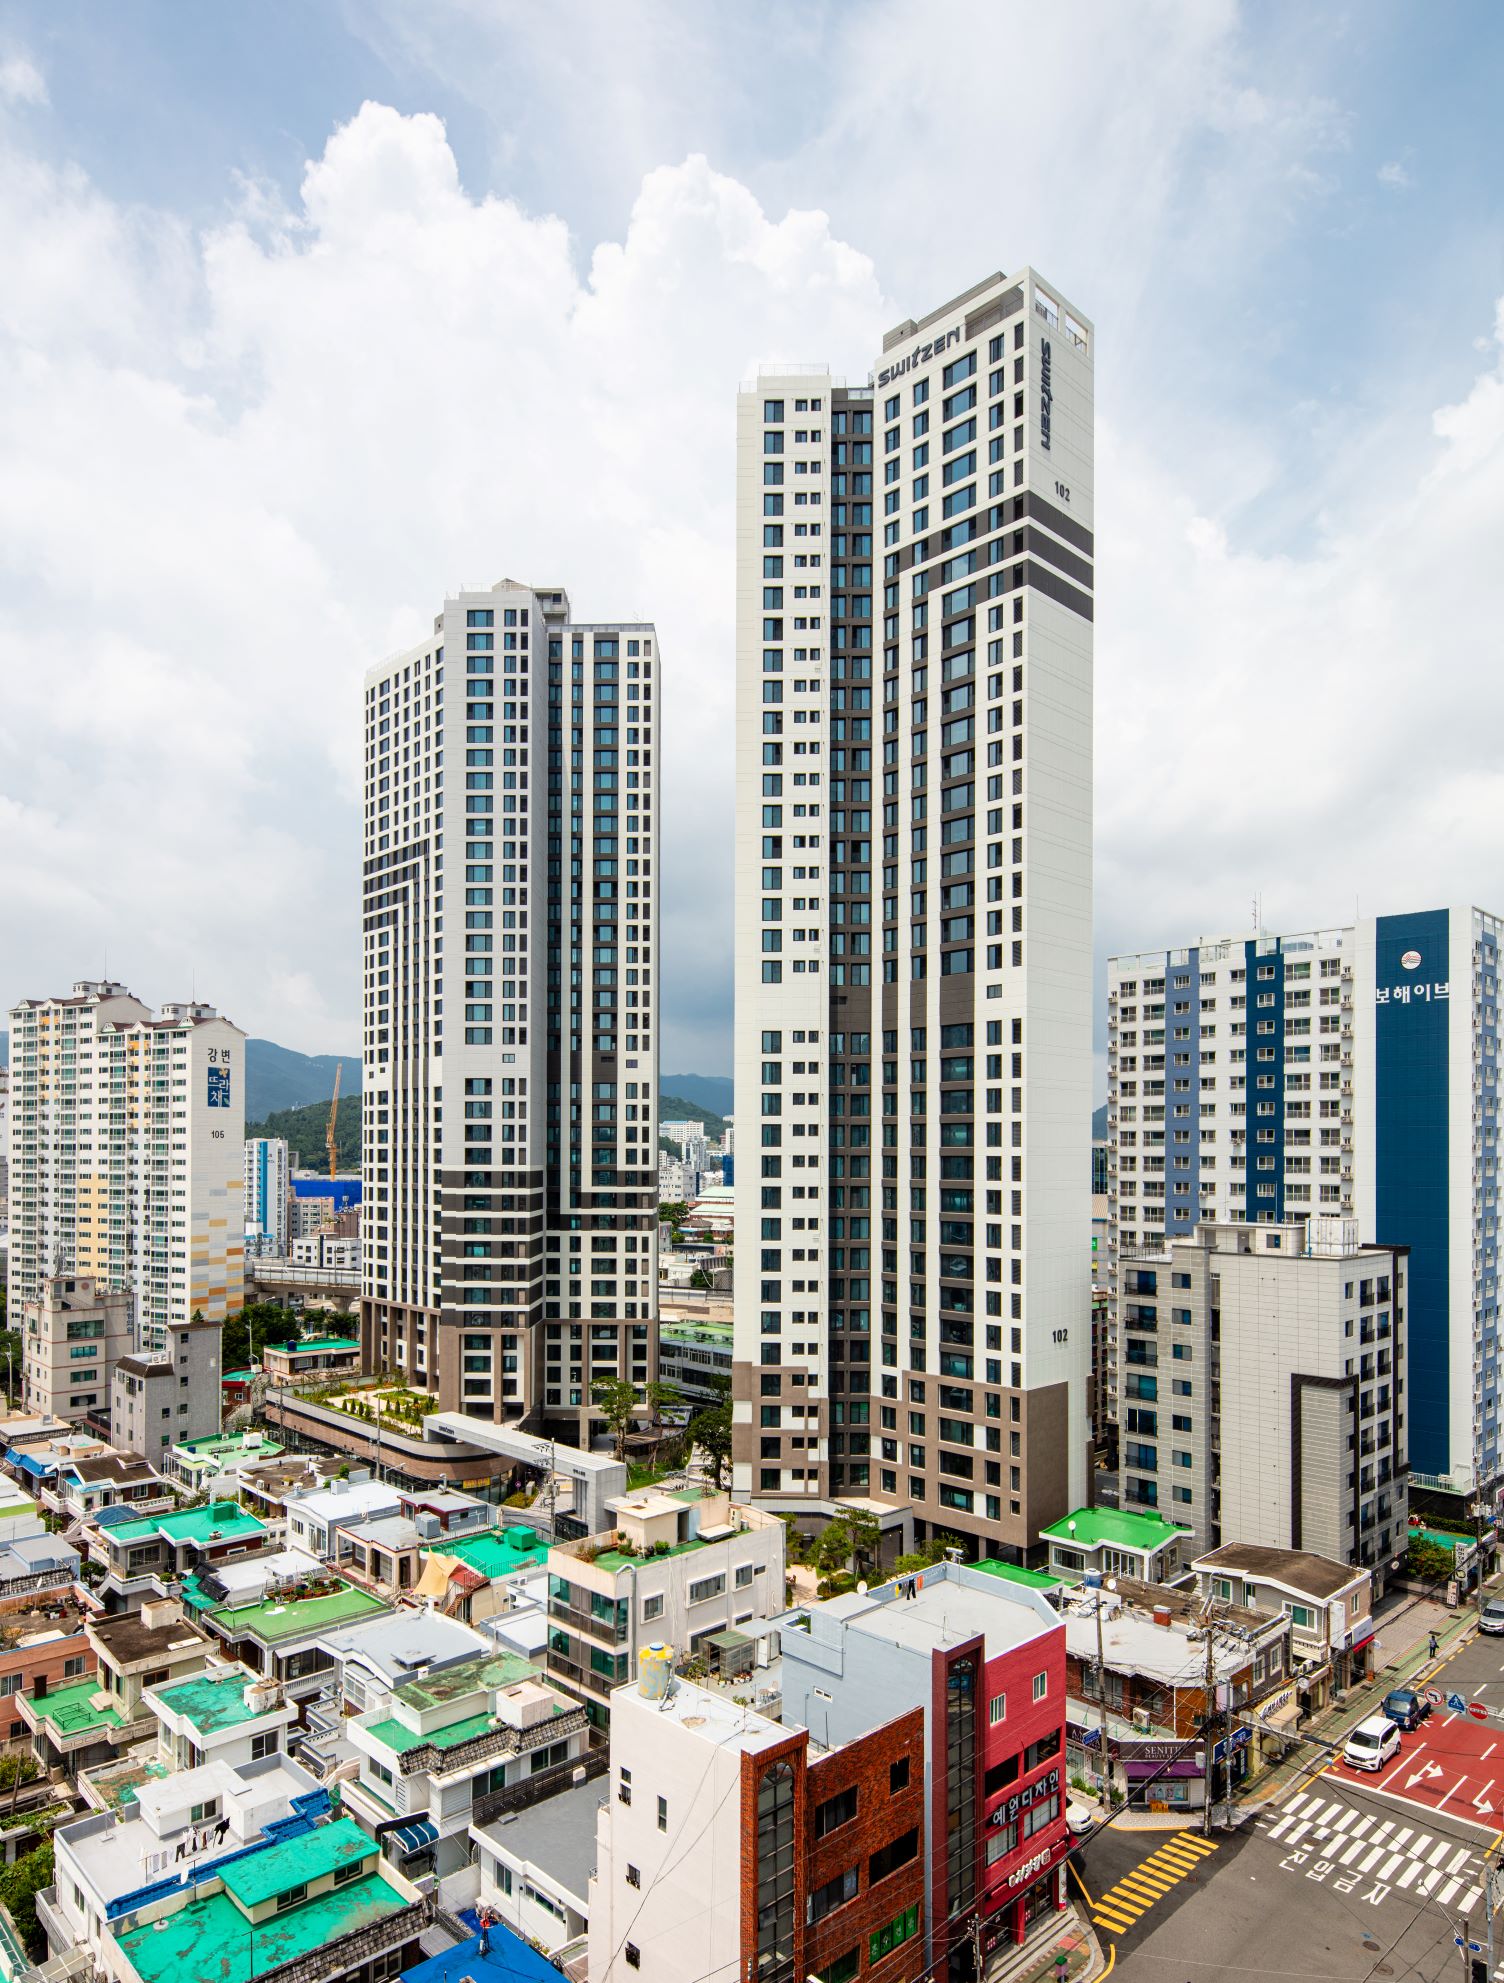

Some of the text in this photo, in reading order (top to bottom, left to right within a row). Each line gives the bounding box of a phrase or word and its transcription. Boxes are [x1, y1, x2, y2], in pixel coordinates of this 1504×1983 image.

[1054, 481, 1071, 502] 102
[1376, 982, 1449, 1004] 보해이브
[207, 1047, 230, 1063] 강변
[211, 1130, 225, 1139] 105
[1052, 1328, 1068, 1343] 102
[993, 1768, 1059, 1826] 예원디자인
[1278, 1849, 1392, 1906] 진입금지
